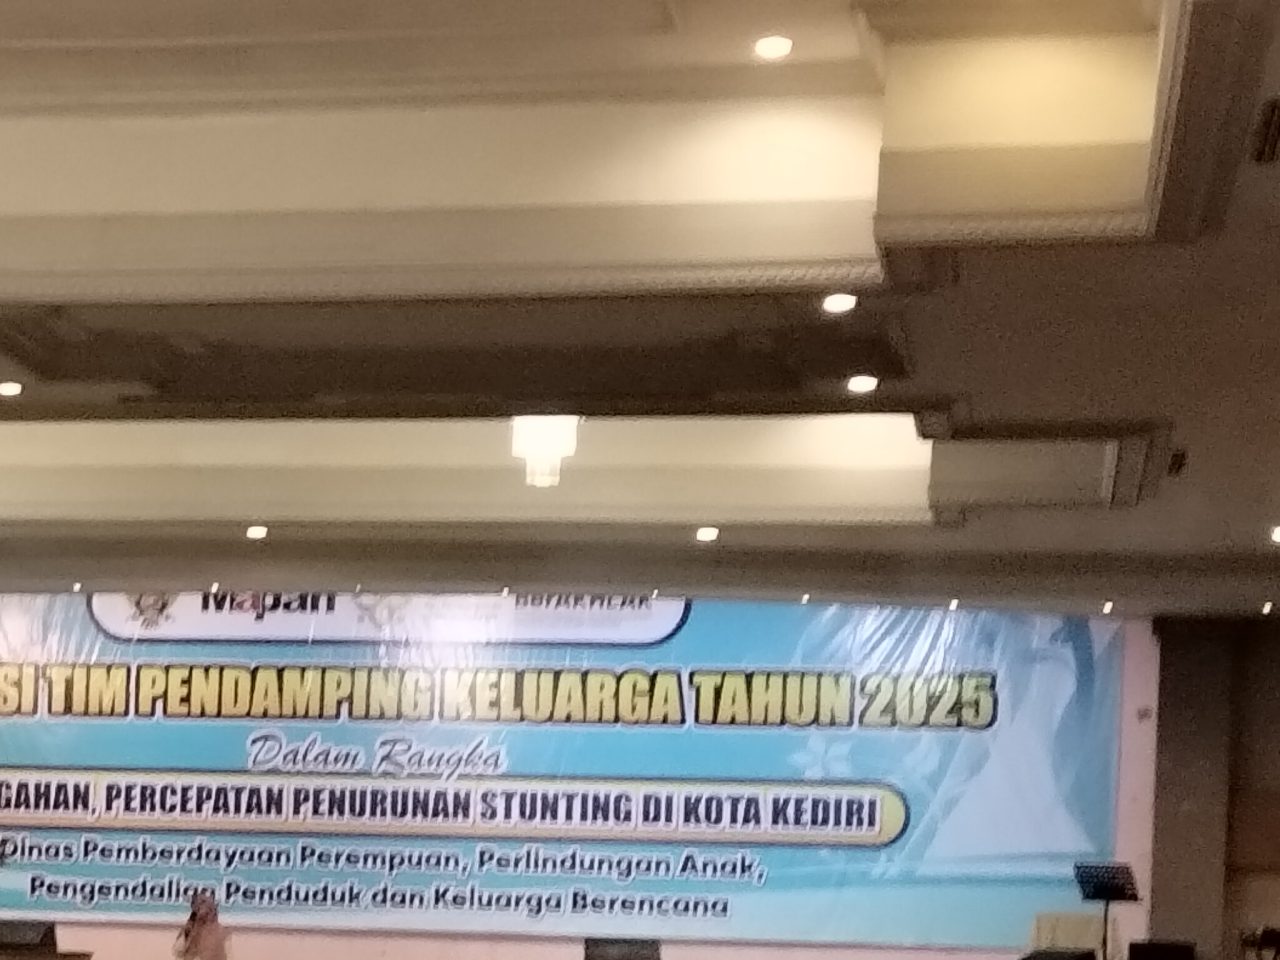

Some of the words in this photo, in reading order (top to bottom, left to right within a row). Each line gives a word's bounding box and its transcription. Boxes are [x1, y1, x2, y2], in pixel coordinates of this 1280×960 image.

[42, 664, 130, 718] TIM
[136, 664, 435, 720] PENDAMPING
[440, 668, 685, 724] KELUARGA
[690, 670, 856, 726] TAHUN
[859, 671, 998, 730] 2025
[250, 733, 362, 770] Dalam
[372, 735, 503, 783] Rangka
[105, 783, 283, 817] PERCEPATAN
[292, 786, 471, 820] PENURUNAN
[479, 789, 632, 822] STUNTING
[642, 793, 674, 823] DI
[683, 794, 762, 826] KOTA
[770, 796, 877, 828] KEDIRI
[0, 838, 74, 861] Dinas
[83, 839, 291, 869] Pemberdayaan
[300, 845, 469, 876] Perempuan,
[477, 849, 671, 879] Perlindungan
[680, 851, 767, 884] Anak,
[224, 880, 363, 906] Penduduk
[372, 885, 425, 908] dan
[434, 886, 562, 917] Keluarga
[572, 889, 729, 918] Berencana
